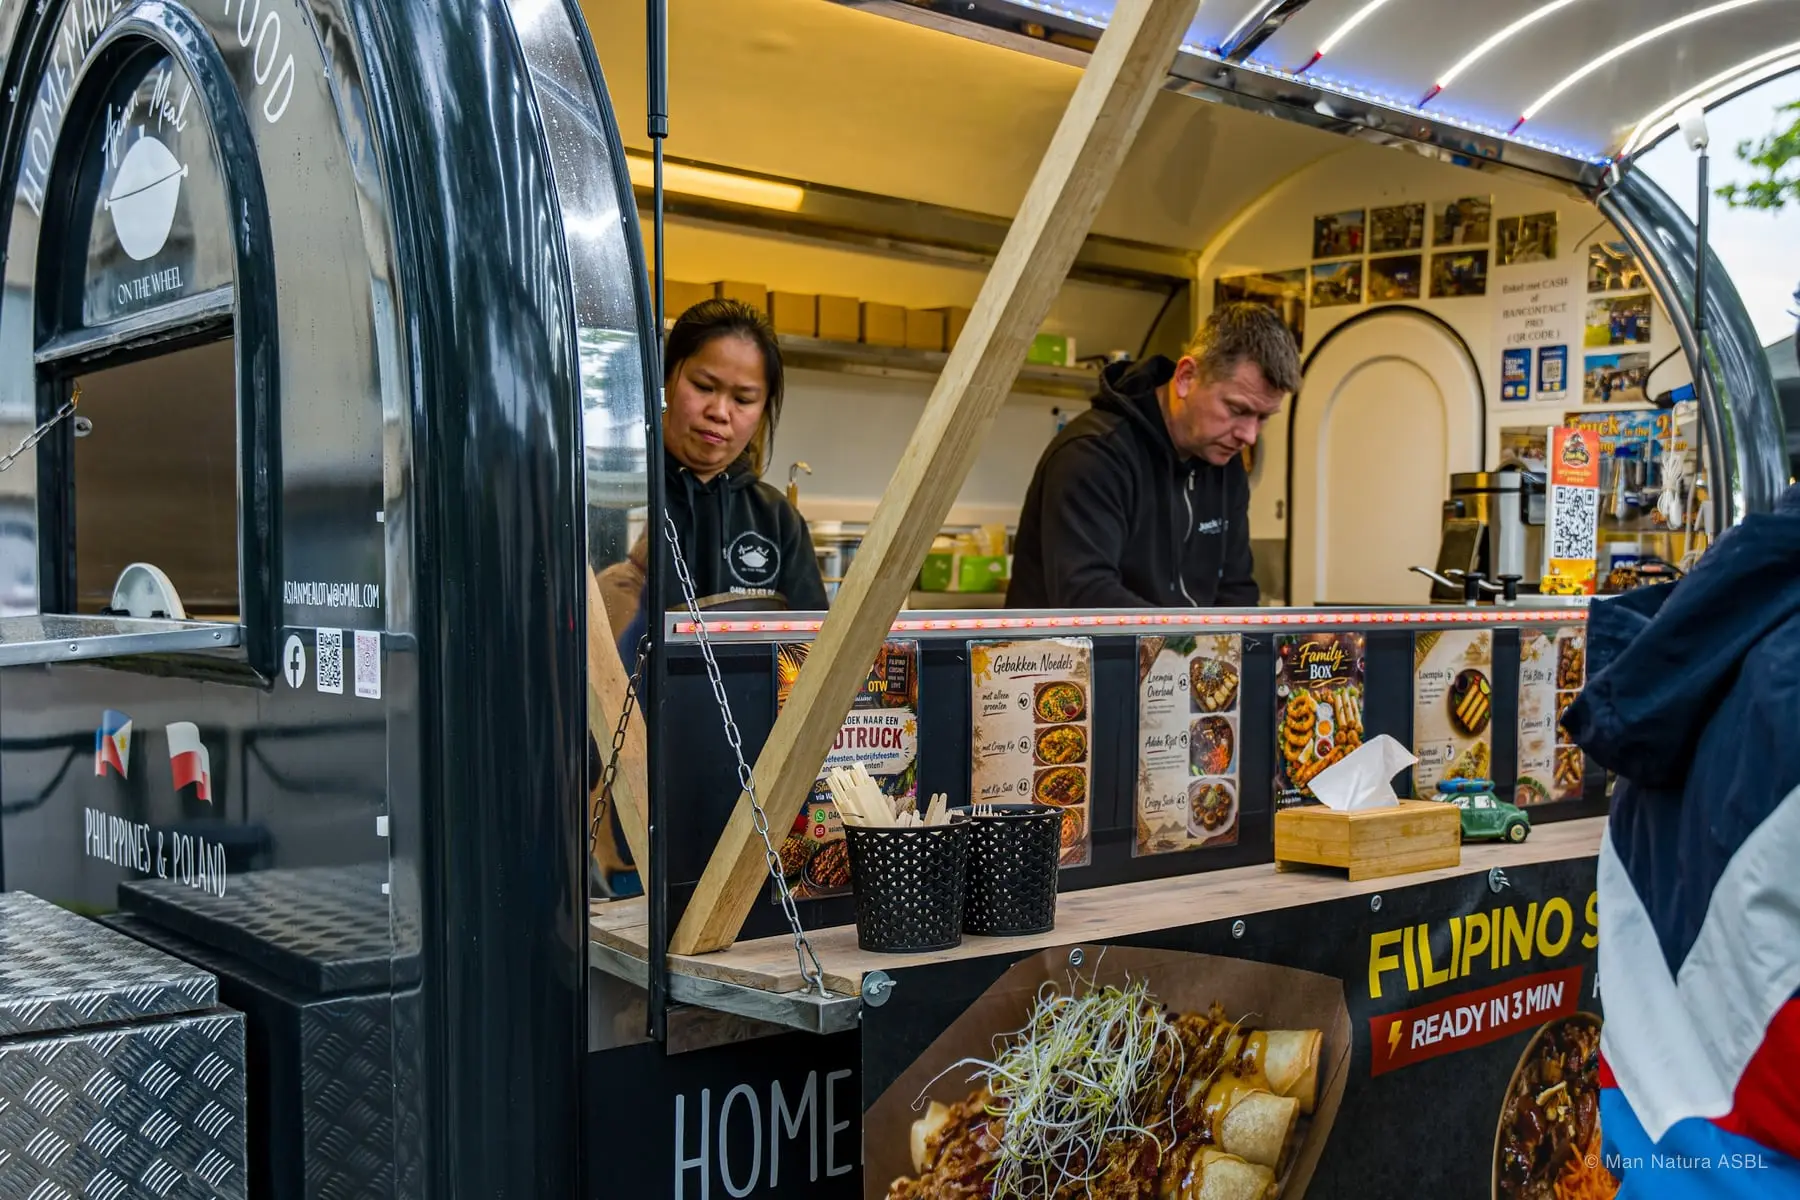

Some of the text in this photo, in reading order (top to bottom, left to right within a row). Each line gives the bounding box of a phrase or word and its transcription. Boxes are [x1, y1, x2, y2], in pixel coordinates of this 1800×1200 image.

[224, 0, 295, 123] OOD
[118, 266, 184, 305] ON THE WHEEL
[1542, 277, 1568, 288] CASH
[993, 652, 1073, 674] Gebakken Noedels
[1298, 640, 1345, 671] Family
[1309, 664, 1332, 679] BOX
[868, 680, 888, 692] OTW
[984, 701, 1007, 714] groenten
[863, 716, 883, 725] NAAR
[885, 716, 899, 725] EEN
[833, 727, 903, 750] DTRUCK
[856, 751, 899, 762] bedrijfsfeesten
[85, 807, 227, 898] PHILIPPINES & POLAND
[1369, 896, 1573, 998] FILIPINO
[1411, 1002, 1486, 1050] READY
[1490, 995, 1509, 1028] IN
[1512, 991, 1523, 1020] 3
[1526, 981, 1564, 1016] MIN
